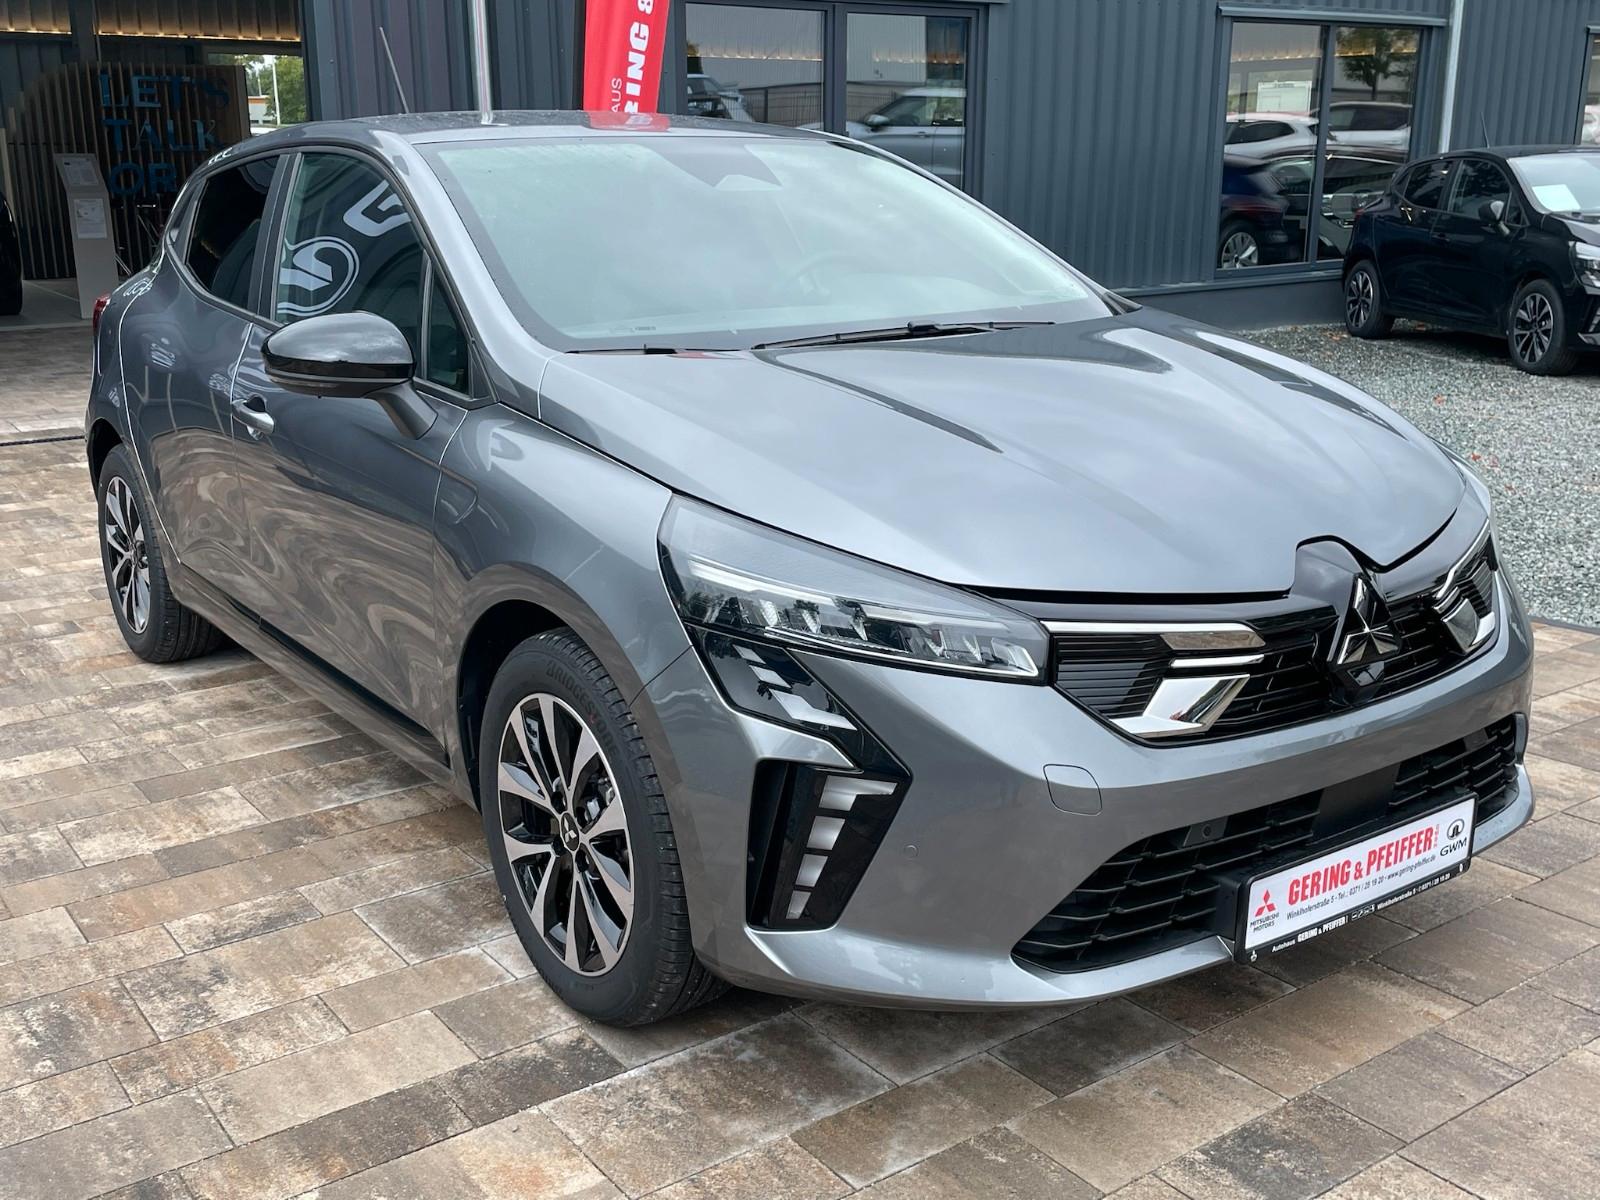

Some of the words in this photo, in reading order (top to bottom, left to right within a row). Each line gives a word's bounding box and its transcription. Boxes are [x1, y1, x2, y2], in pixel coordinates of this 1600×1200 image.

[102, 119, 225, 152] TALK
[546, 660, 618, 761] BRIDGESTONE
[1440, 837, 1467, 856] GWM
[1288, 860, 1351, 905] GERING
[1354, 861, 1363, 880] &
[1366, 827, 1434, 876] PFEIFFER
[1250, 913, 1279, 927] MITSUBISHI
[1253, 921, 1275, 932] MOTORS
[1271, 939, 1296, 953] Autohaus
[1297, 928, 1318, 943] GERING
[1323, 916, 1346, 933] PFEIFFER
